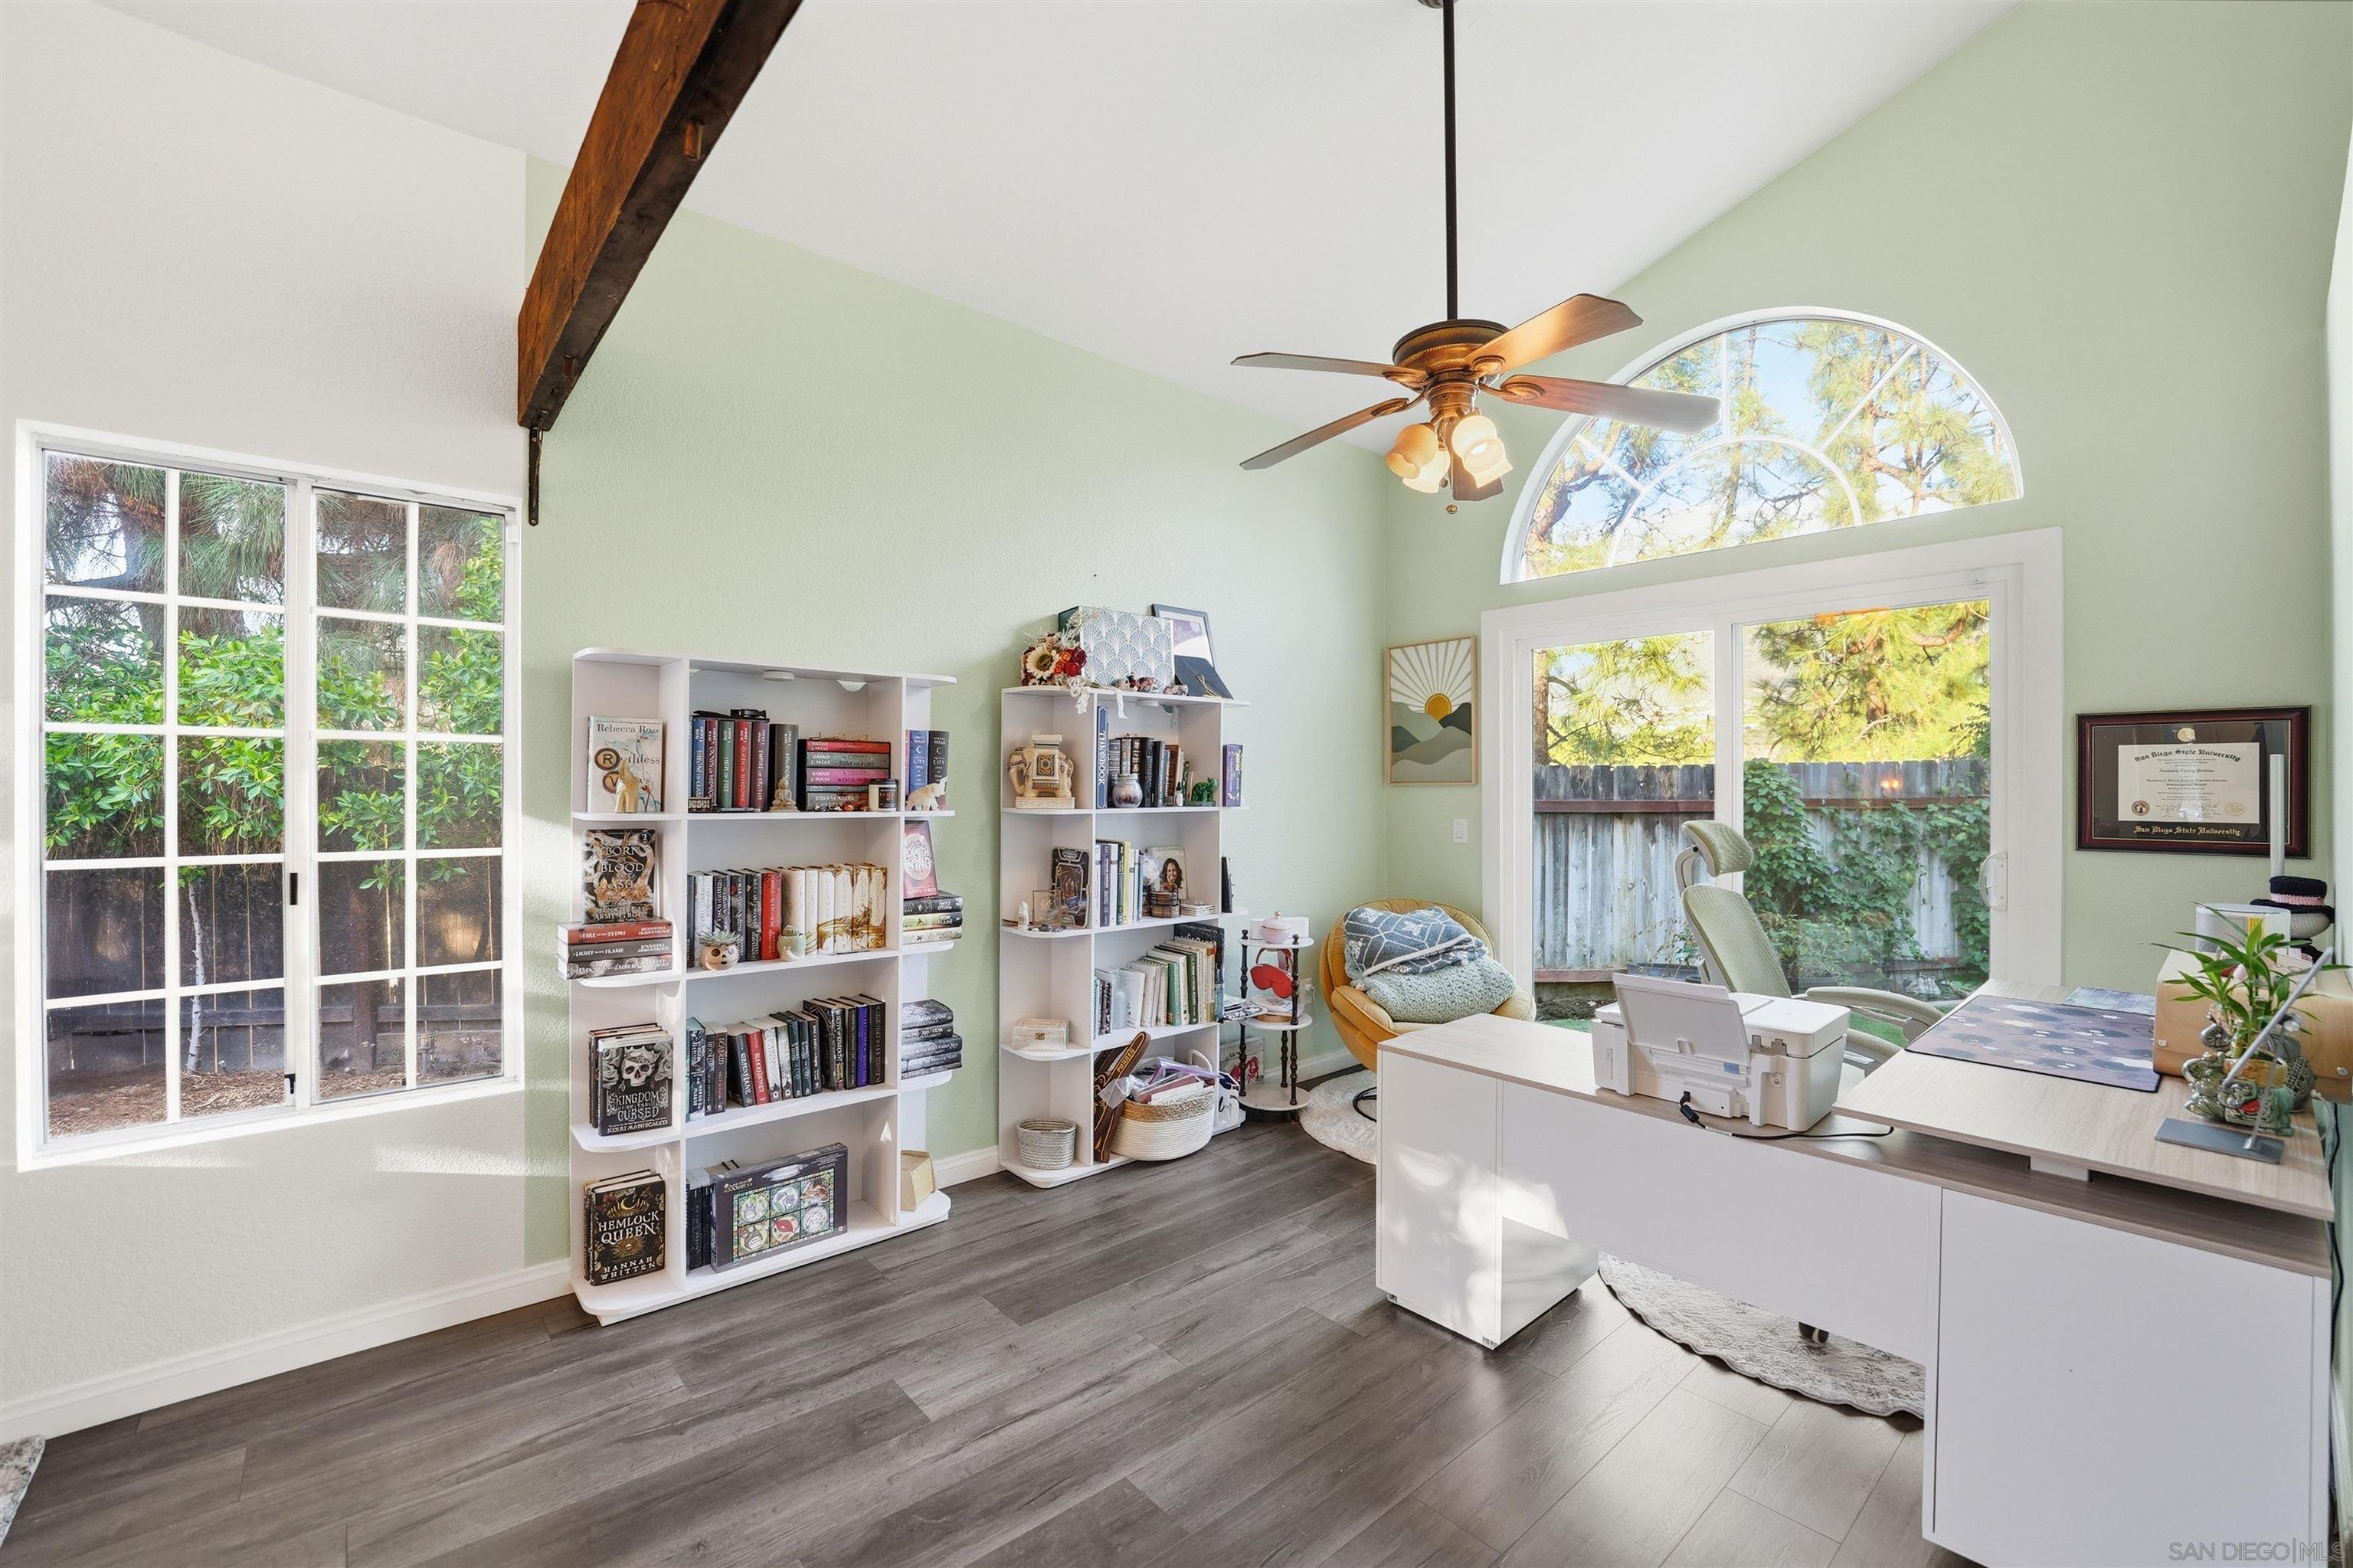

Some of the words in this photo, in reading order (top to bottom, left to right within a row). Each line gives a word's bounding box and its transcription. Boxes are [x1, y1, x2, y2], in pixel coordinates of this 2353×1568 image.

[597, 723, 635, 733] Rebecca
[639, 725, 659, 734] Ross
[2198, 748, 2242, 763] University
[2134, 825, 2150, 833] San
[2151, 826, 2173, 835] Diego
[2174, 826, 2197, 834] State
[2198, 827, 2242, 836] University
[606, 846, 642, 856] BORN
[601, 863, 644, 872] BLOOD
[615, 1090, 659, 1106] KINGDOM
[617, 1106, 659, 1121] CURSED
[627, 1120, 668, 1131] MANISCALCO
[598, 1210, 659, 1232] HEMLOCK
[601, 1222, 656, 1245] QUEEN
[600, 1262, 656, 1281] WHITTEN
[604, 1256, 653, 1273] HANNAH
